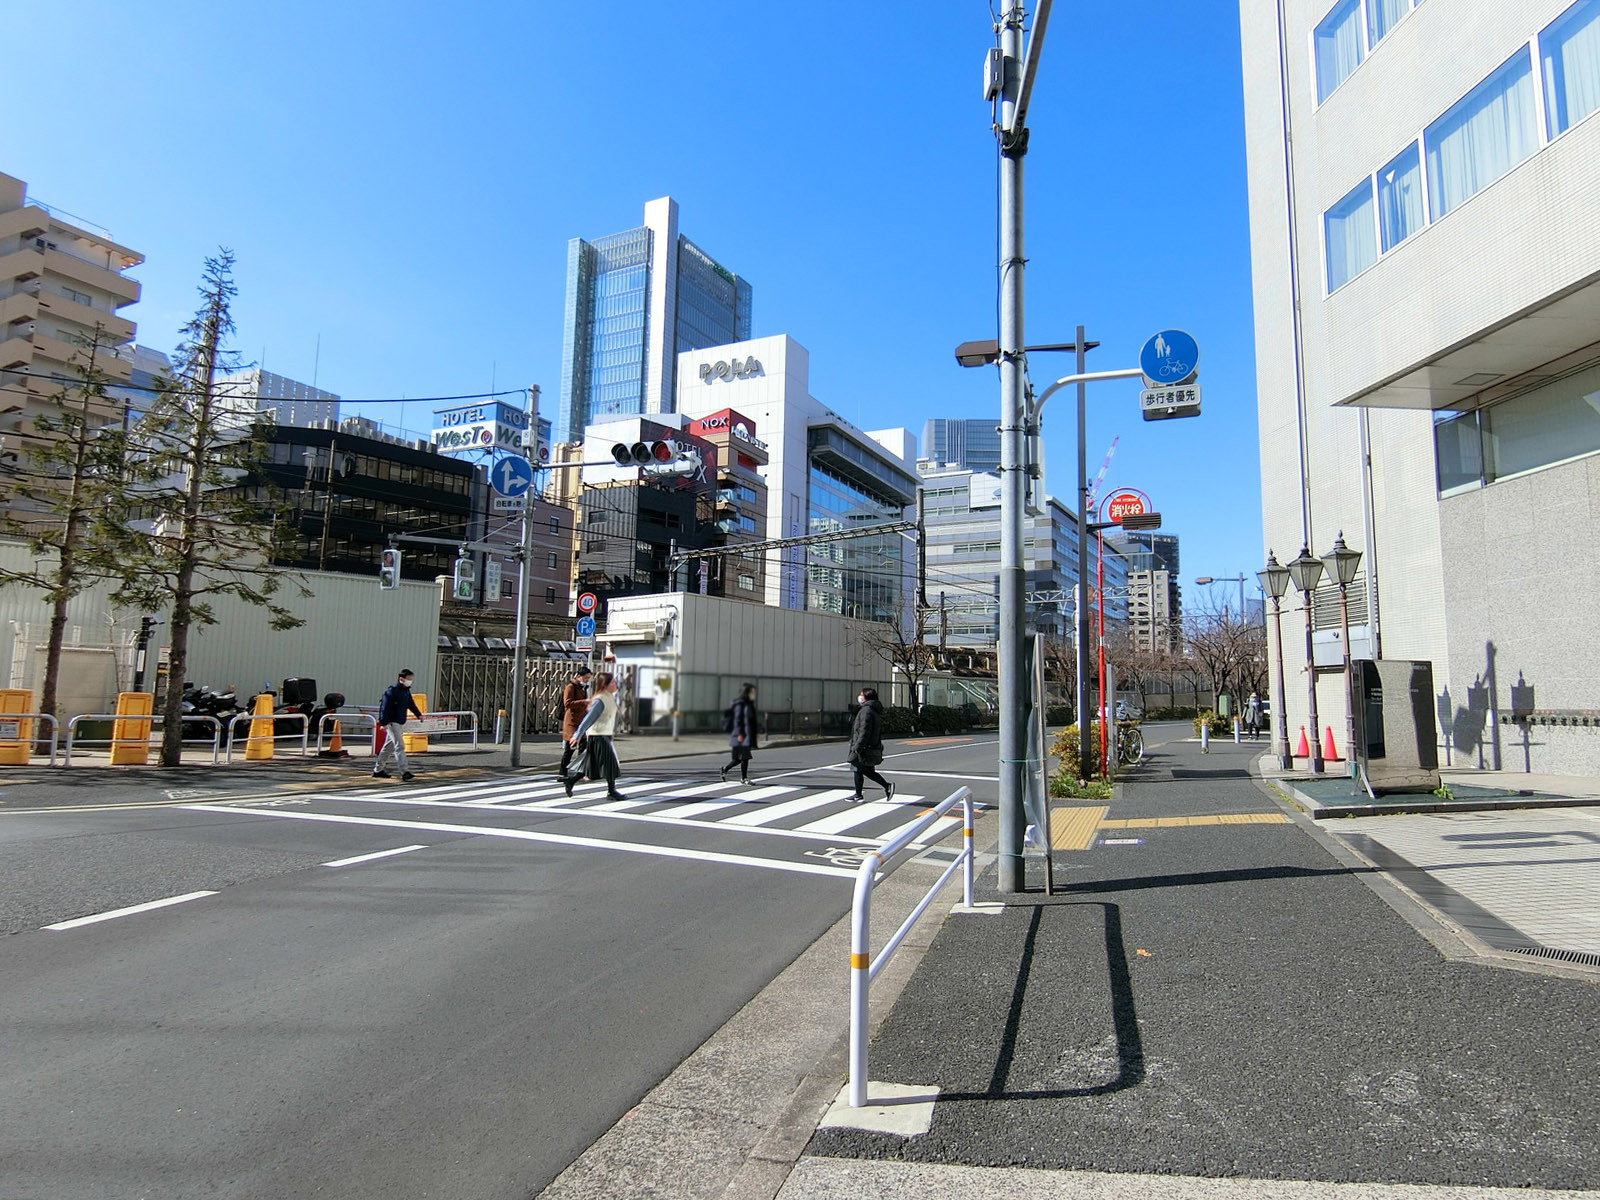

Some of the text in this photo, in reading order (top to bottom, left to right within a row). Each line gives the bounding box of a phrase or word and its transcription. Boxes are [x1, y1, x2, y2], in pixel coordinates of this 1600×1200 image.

[699, 355, 758, 380] POLA
[1146, 389, 1195, 406] 歩行者優先
[442, 408, 485, 427] HOTEL
[701, 416, 729, 430] NOX
[1111, 503, 1142, 518] 消火栓
[582, 598, 593, 606] 40
[580, 621, 589, 634] P
